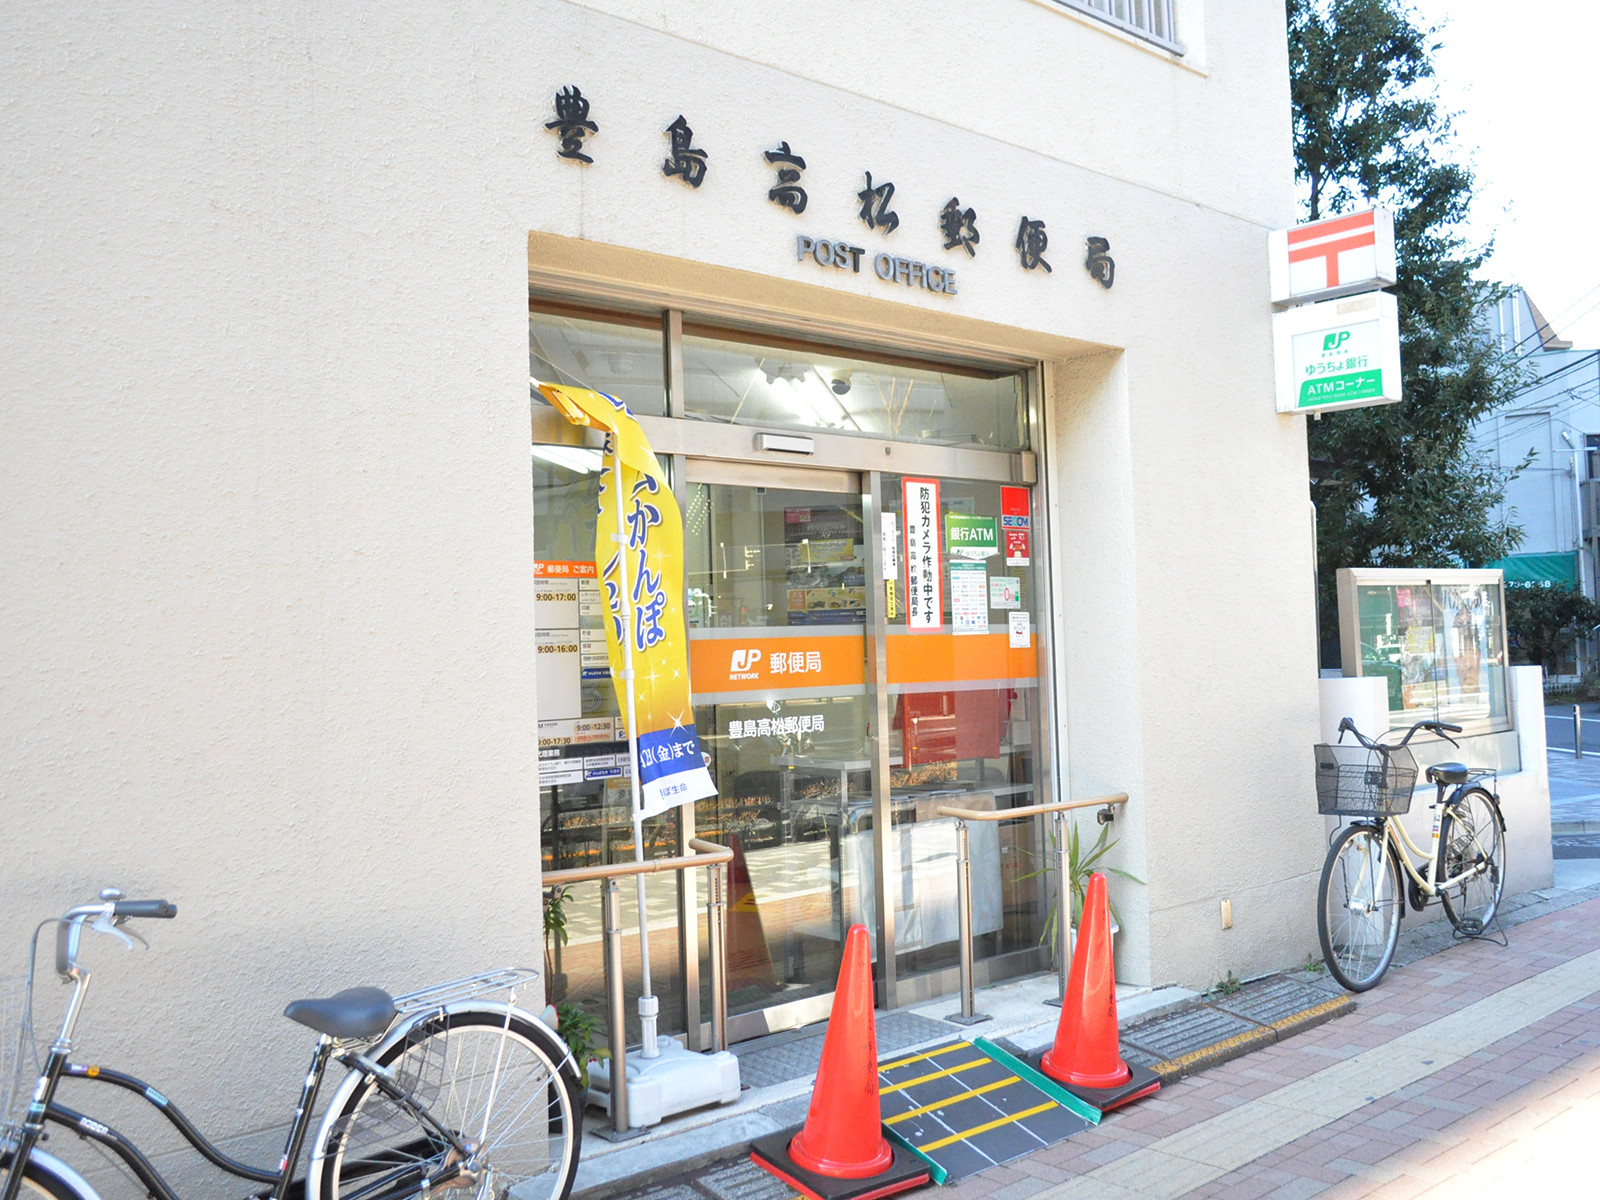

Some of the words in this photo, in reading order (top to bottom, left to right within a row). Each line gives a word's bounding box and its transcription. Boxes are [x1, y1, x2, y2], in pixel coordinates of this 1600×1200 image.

[797, 234, 866, 274] POST
[874, 252, 958, 295] OFFICE
[1305, 355, 1368, 376] ゆうちょ銀行
[1308, 377, 1375, 395] ATMコーナー
[1003, 516, 1029, 527] SECOM
[950, 527, 993, 540] 銀行ATM
[920, 487, 933, 624] 防犯カメラ作動中です
[547, 565, 569, 574] 郵便局
[573, 565, 595, 574] ご案内
[536, 593, 577, 602] 9:00-17:00
[537, 645, 578, 654] 9:00-16:00
[770, 651, 822, 674] 郵便局
[729, 715, 824, 739] 豊島高松郵便局
